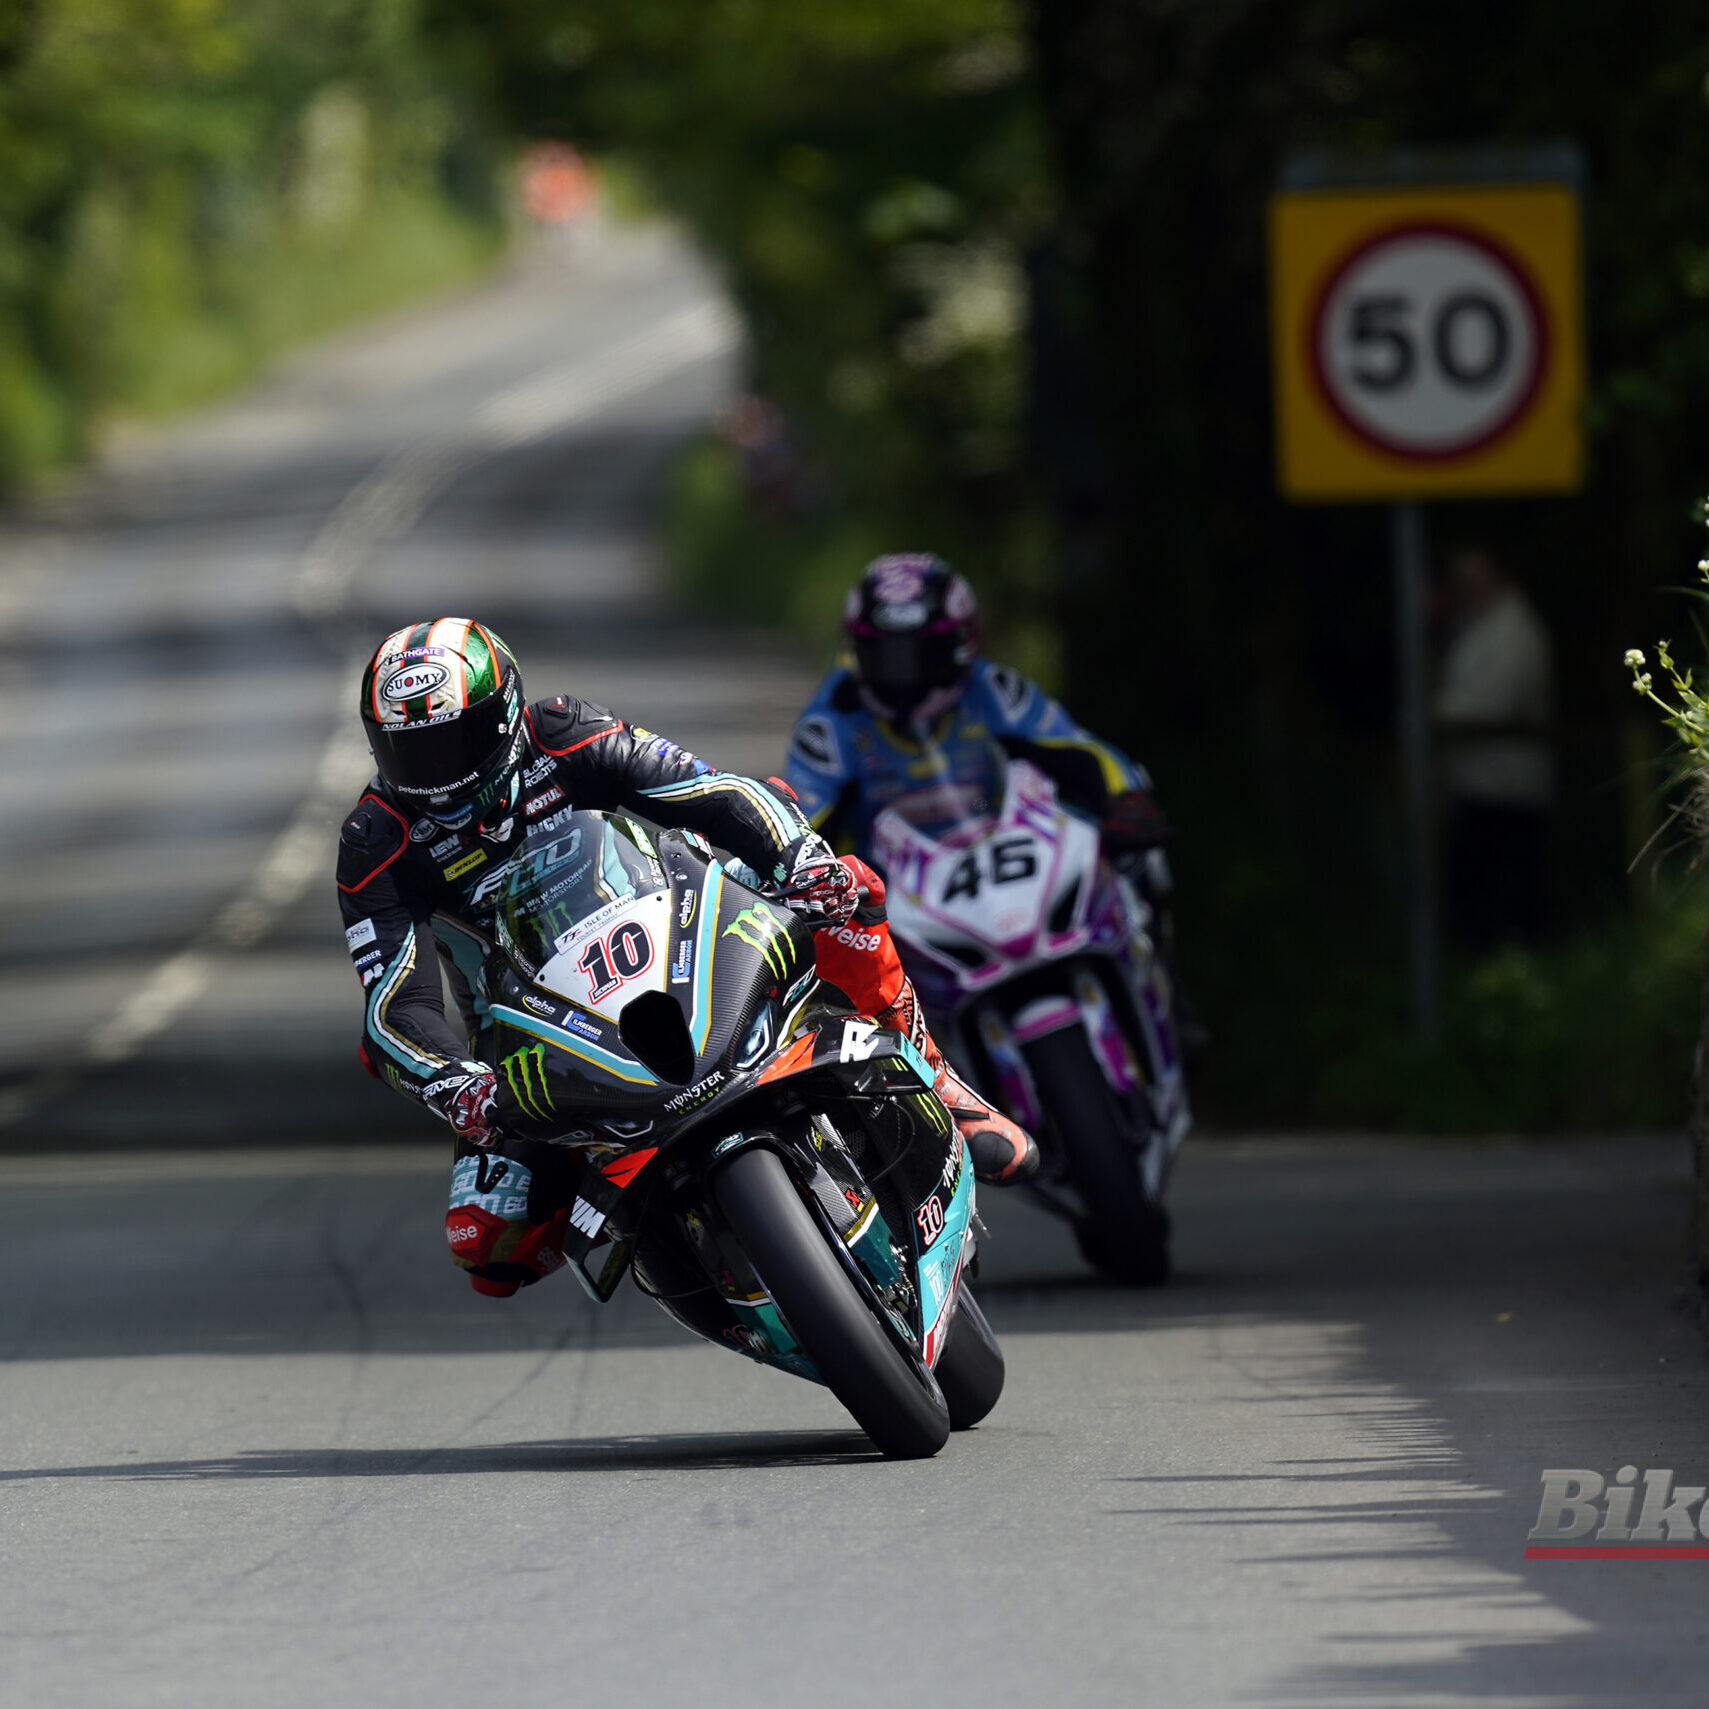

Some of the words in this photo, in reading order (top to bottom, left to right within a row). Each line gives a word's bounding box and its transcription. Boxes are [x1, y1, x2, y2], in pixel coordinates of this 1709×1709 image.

[1349, 293, 1513, 393] 50
[391, 648, 441, 662] BATHGATE
[387, 672, 441, 691] SUOMY
[382, 718, 427, 730] NOLAN
[429, 709, 462, 723] OILS
[398, 771, 480, 796] peterhickman.net
[525, 759, 557, 788] ROBOTS
[526, 788, 561, 815] MOTUL
[943, 837, 1038, 905] 46
[584, 914, 601, 929] ISLE
[615, 897, 634, 909] MAN
[679, 889, 694, 925] alpha
[577, 919, 655, 1005] 10
[525, 996, 556, 1014] alpha
[664, 1070, 725, 1112] MONSTER
[917, 1195, 944, 1246] 10
